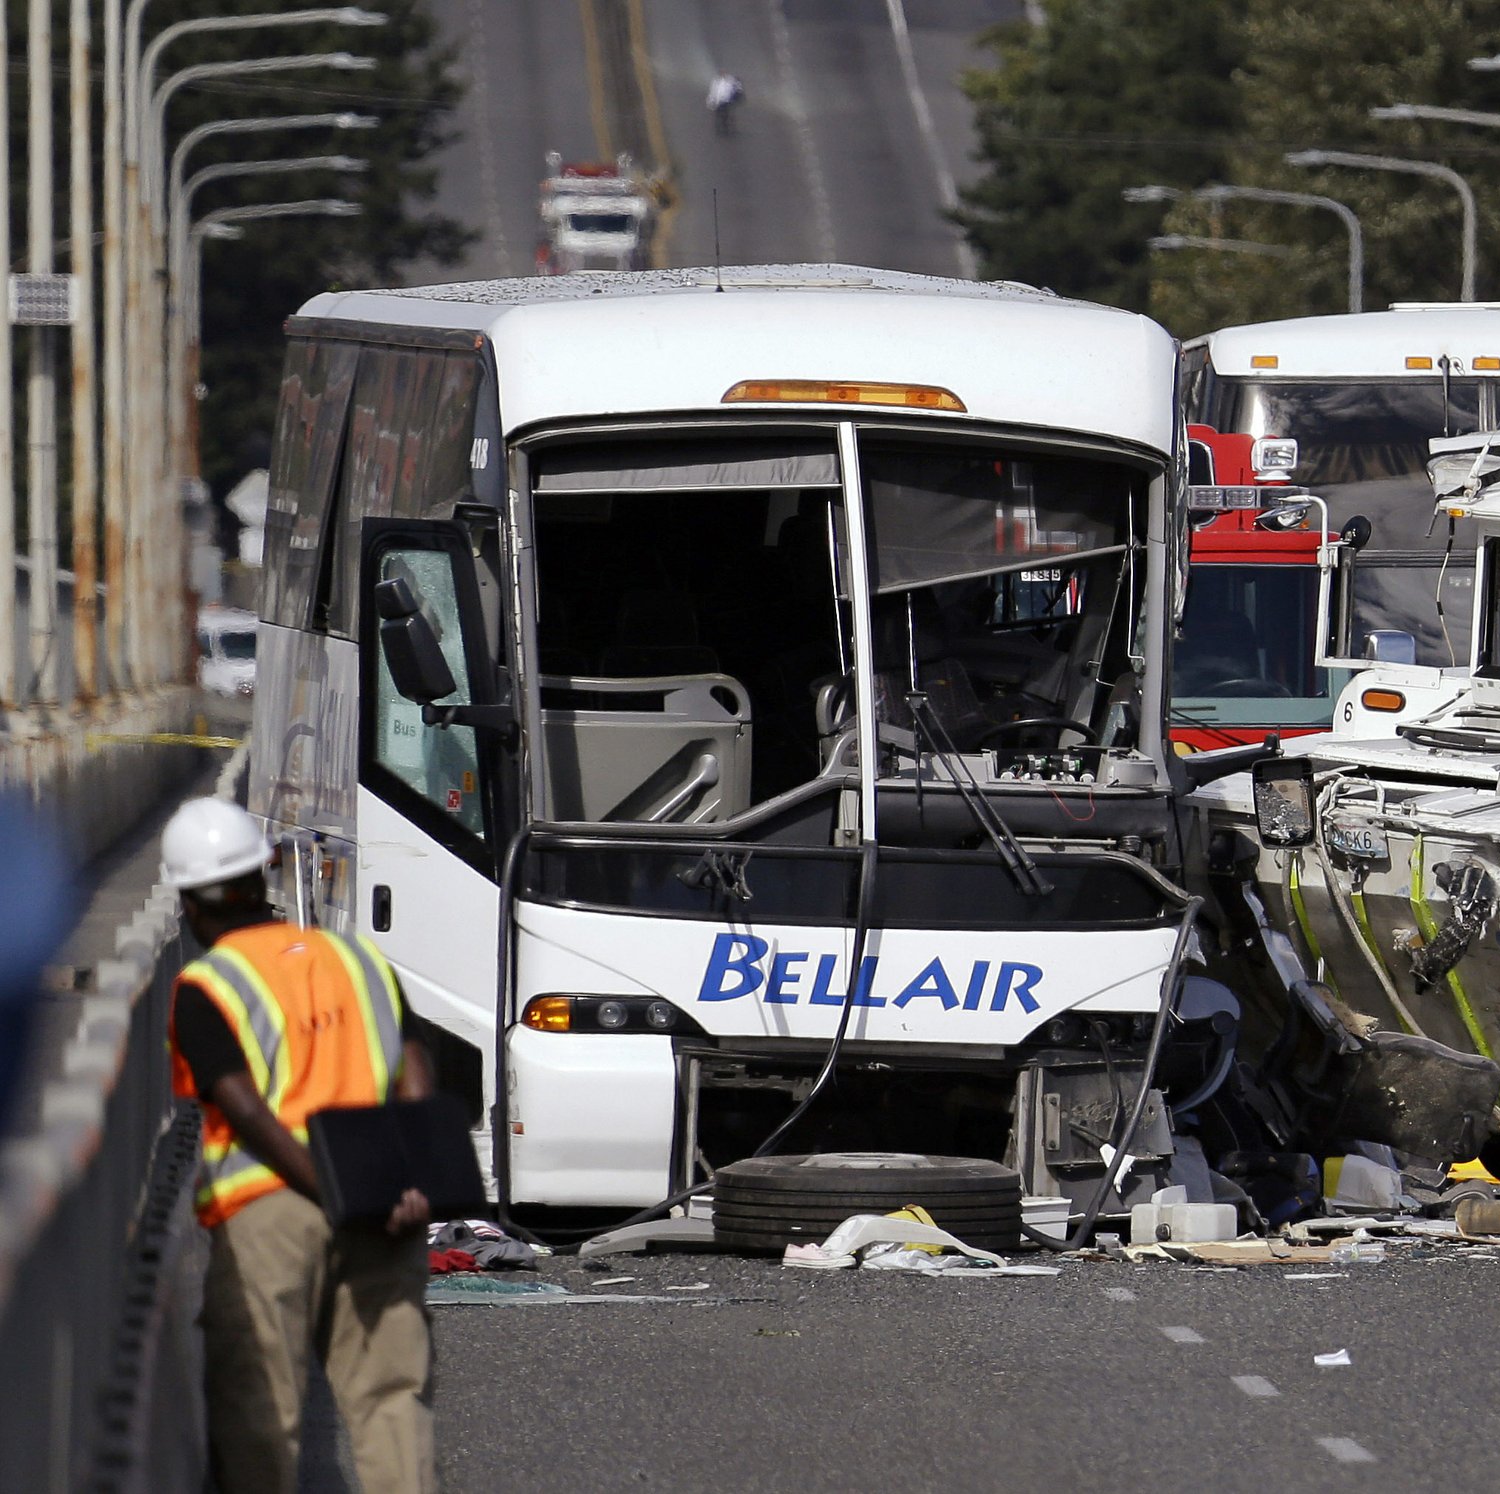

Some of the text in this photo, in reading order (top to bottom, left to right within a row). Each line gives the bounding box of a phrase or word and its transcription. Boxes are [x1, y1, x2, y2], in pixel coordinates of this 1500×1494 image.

[1344, 701, 1354, 723] 6
[393, 720, 416, 737] Bus
[697, 932, 1044, 1015] BELLAIR
